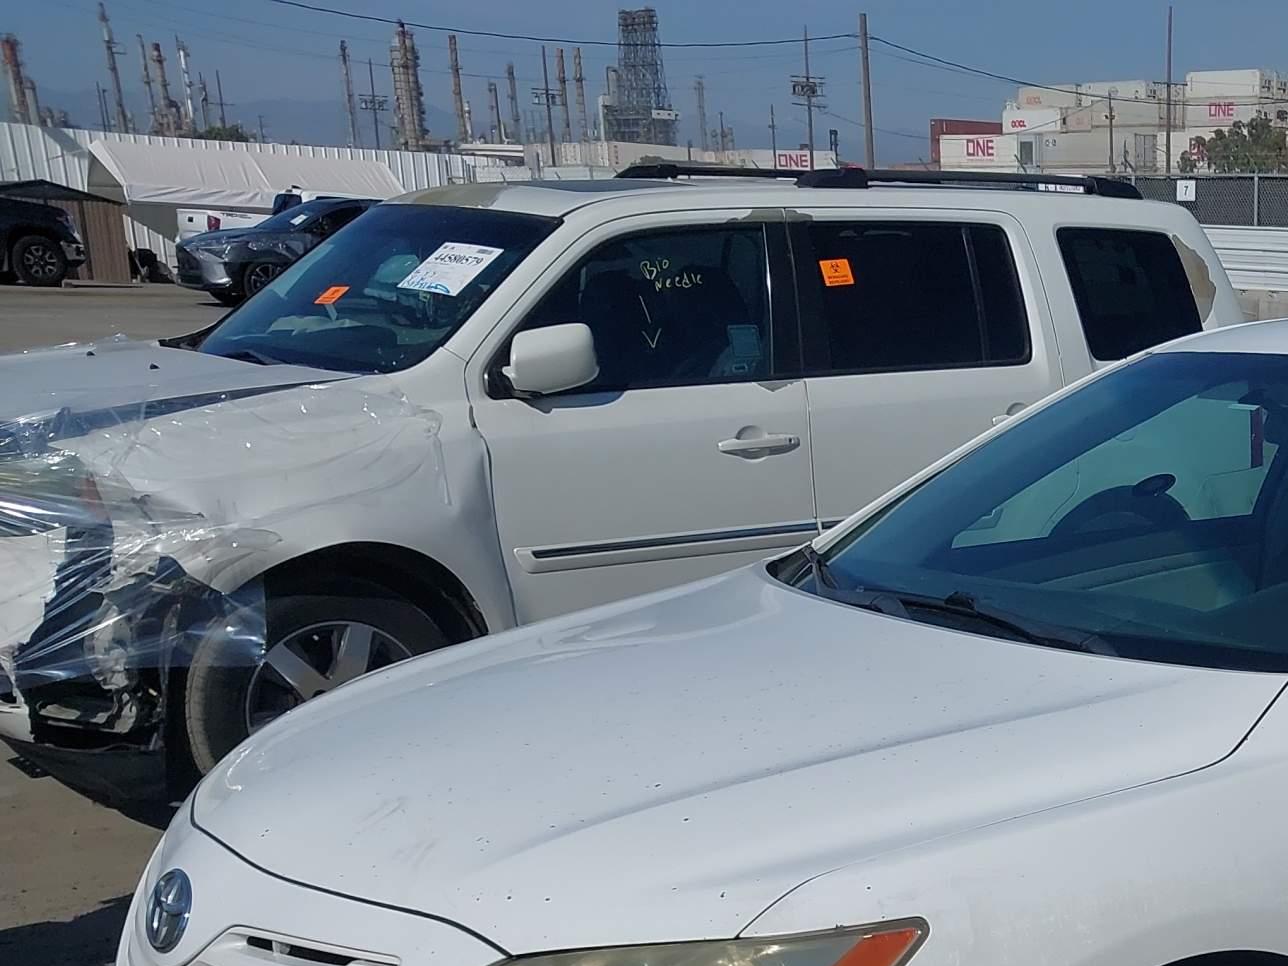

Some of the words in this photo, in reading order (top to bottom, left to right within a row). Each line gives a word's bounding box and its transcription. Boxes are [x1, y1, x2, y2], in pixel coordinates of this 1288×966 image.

[1208, 101, 1235, 118] ONE
[966, 138, 995, 157] ONE
[778, 153, 809, 168] ONE
[1183, 185, 1189, 197] 7
[640, 258, 670, 280] Bio
